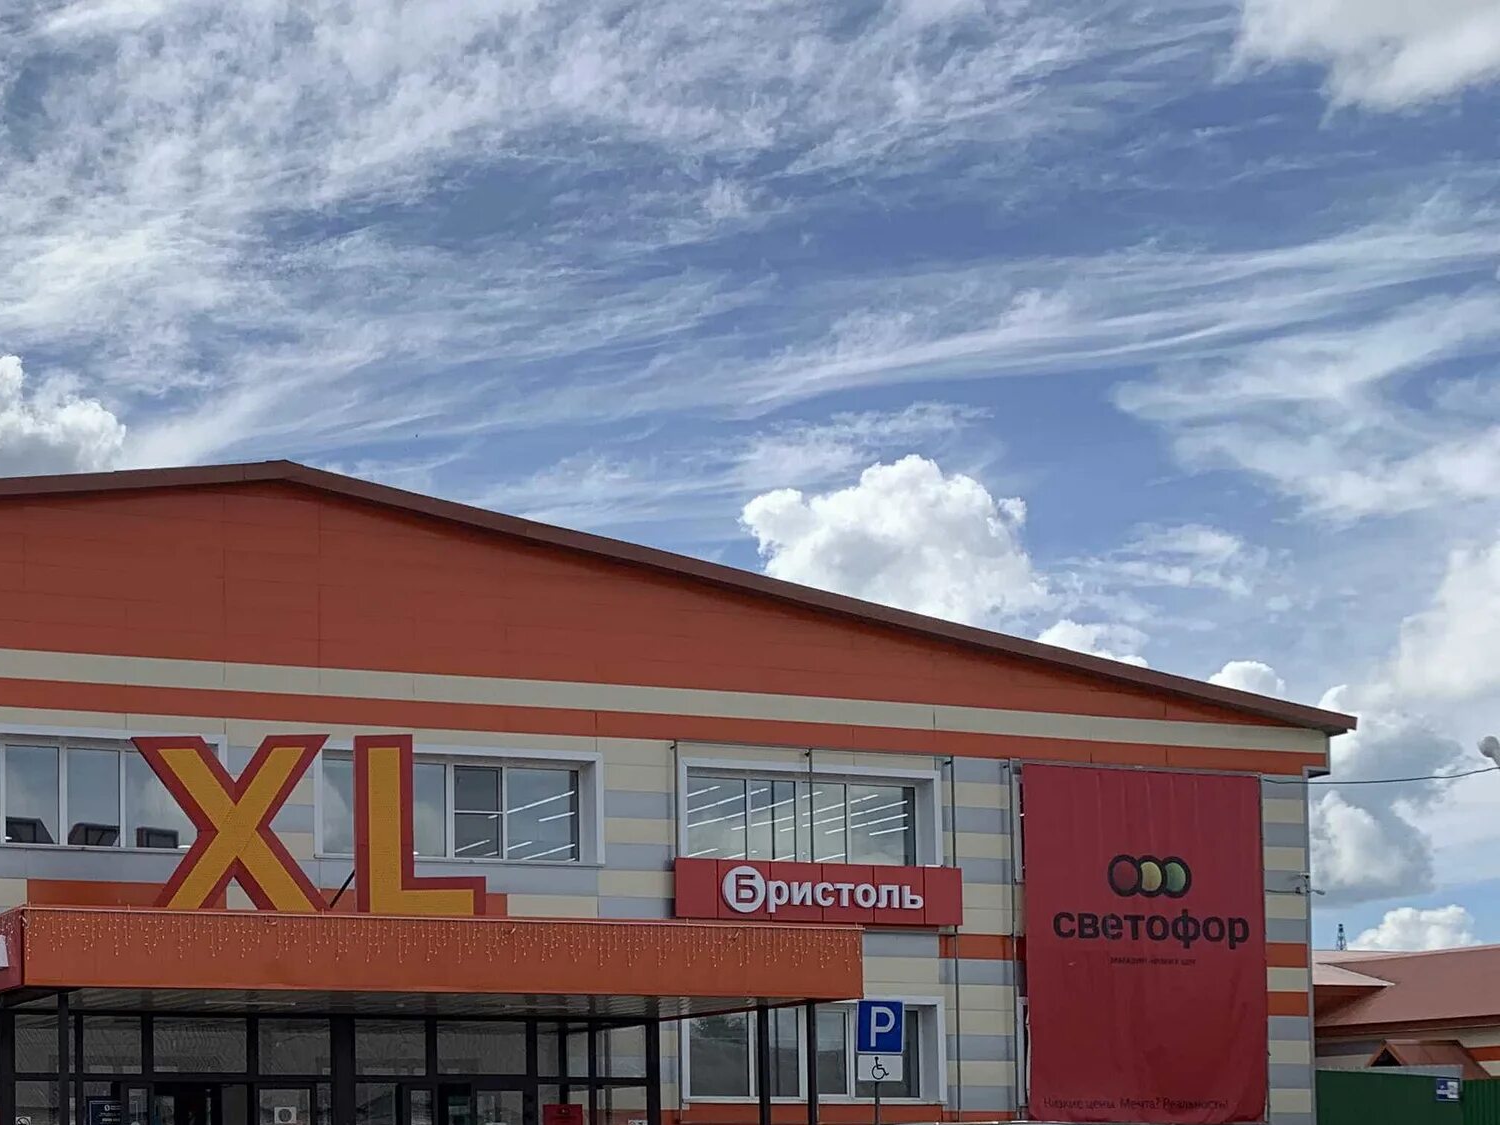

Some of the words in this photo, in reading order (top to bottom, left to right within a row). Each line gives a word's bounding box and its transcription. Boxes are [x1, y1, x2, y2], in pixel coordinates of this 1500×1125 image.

[130, 733, 487, 917] XL
[722, 865, 924, 914] Бристоль
[1052, 908, 1250, 950] светофор
